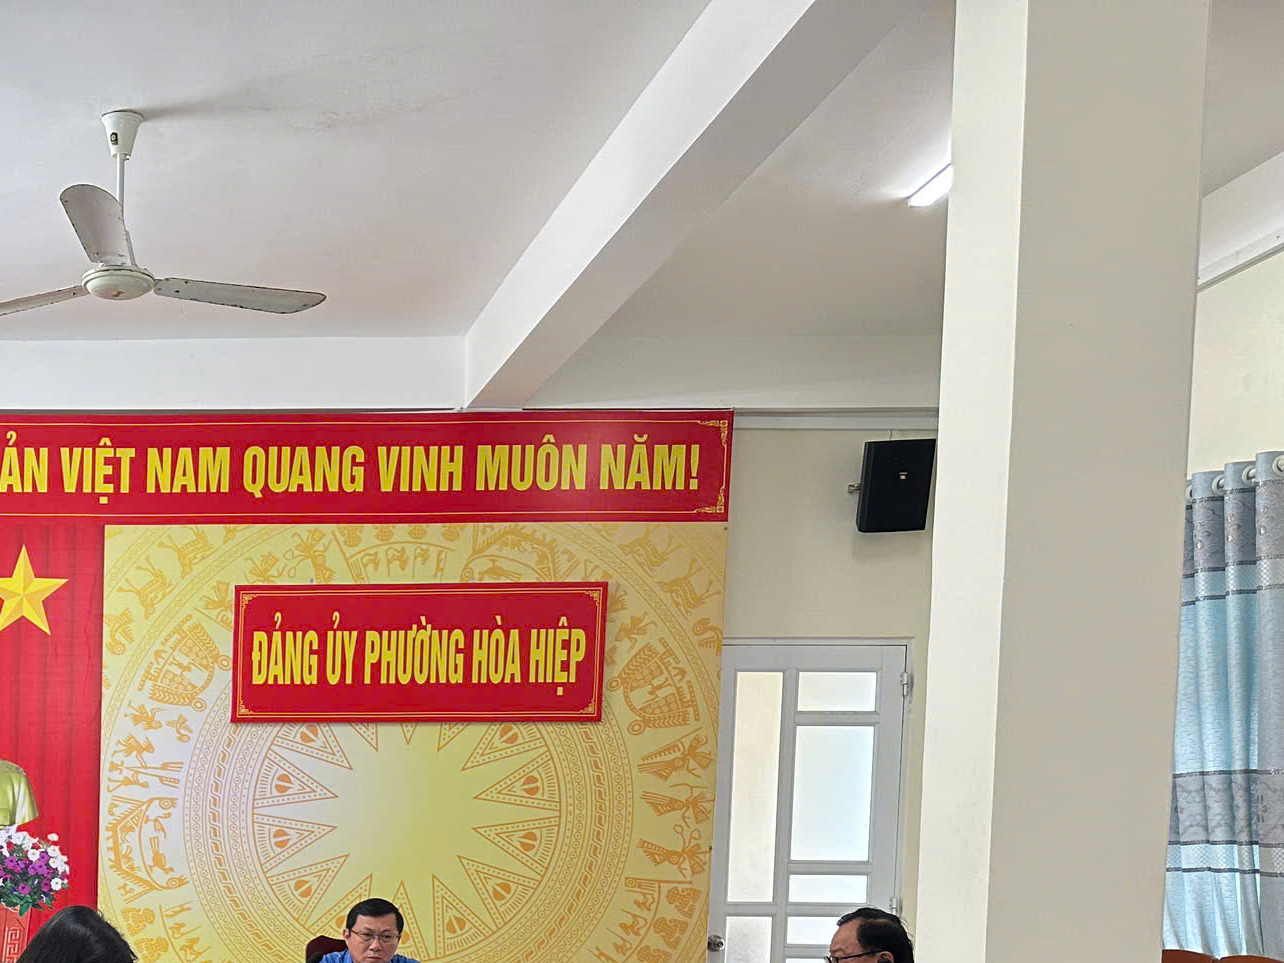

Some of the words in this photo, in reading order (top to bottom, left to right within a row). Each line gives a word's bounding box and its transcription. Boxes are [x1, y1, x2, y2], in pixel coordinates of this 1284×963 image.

[60, 438, 134, 505] VIỆT
[145, 446, 232, 494] NAM
[243, 445, 366, 500] QUANG
[377, 445, 465, 493] VINH
[475, 434, 589, 492] MUÔN
[599, 433, 701, 491] NĂM!
[251, 611, 320, 686] ĐẢNG
[325, 611, 359, 686] ỦY
[364, 615, 466, 686] PHƯỜNG
[472, 615, 523, 685] HÒA
[528, 616, 588, 697] HIỆP
